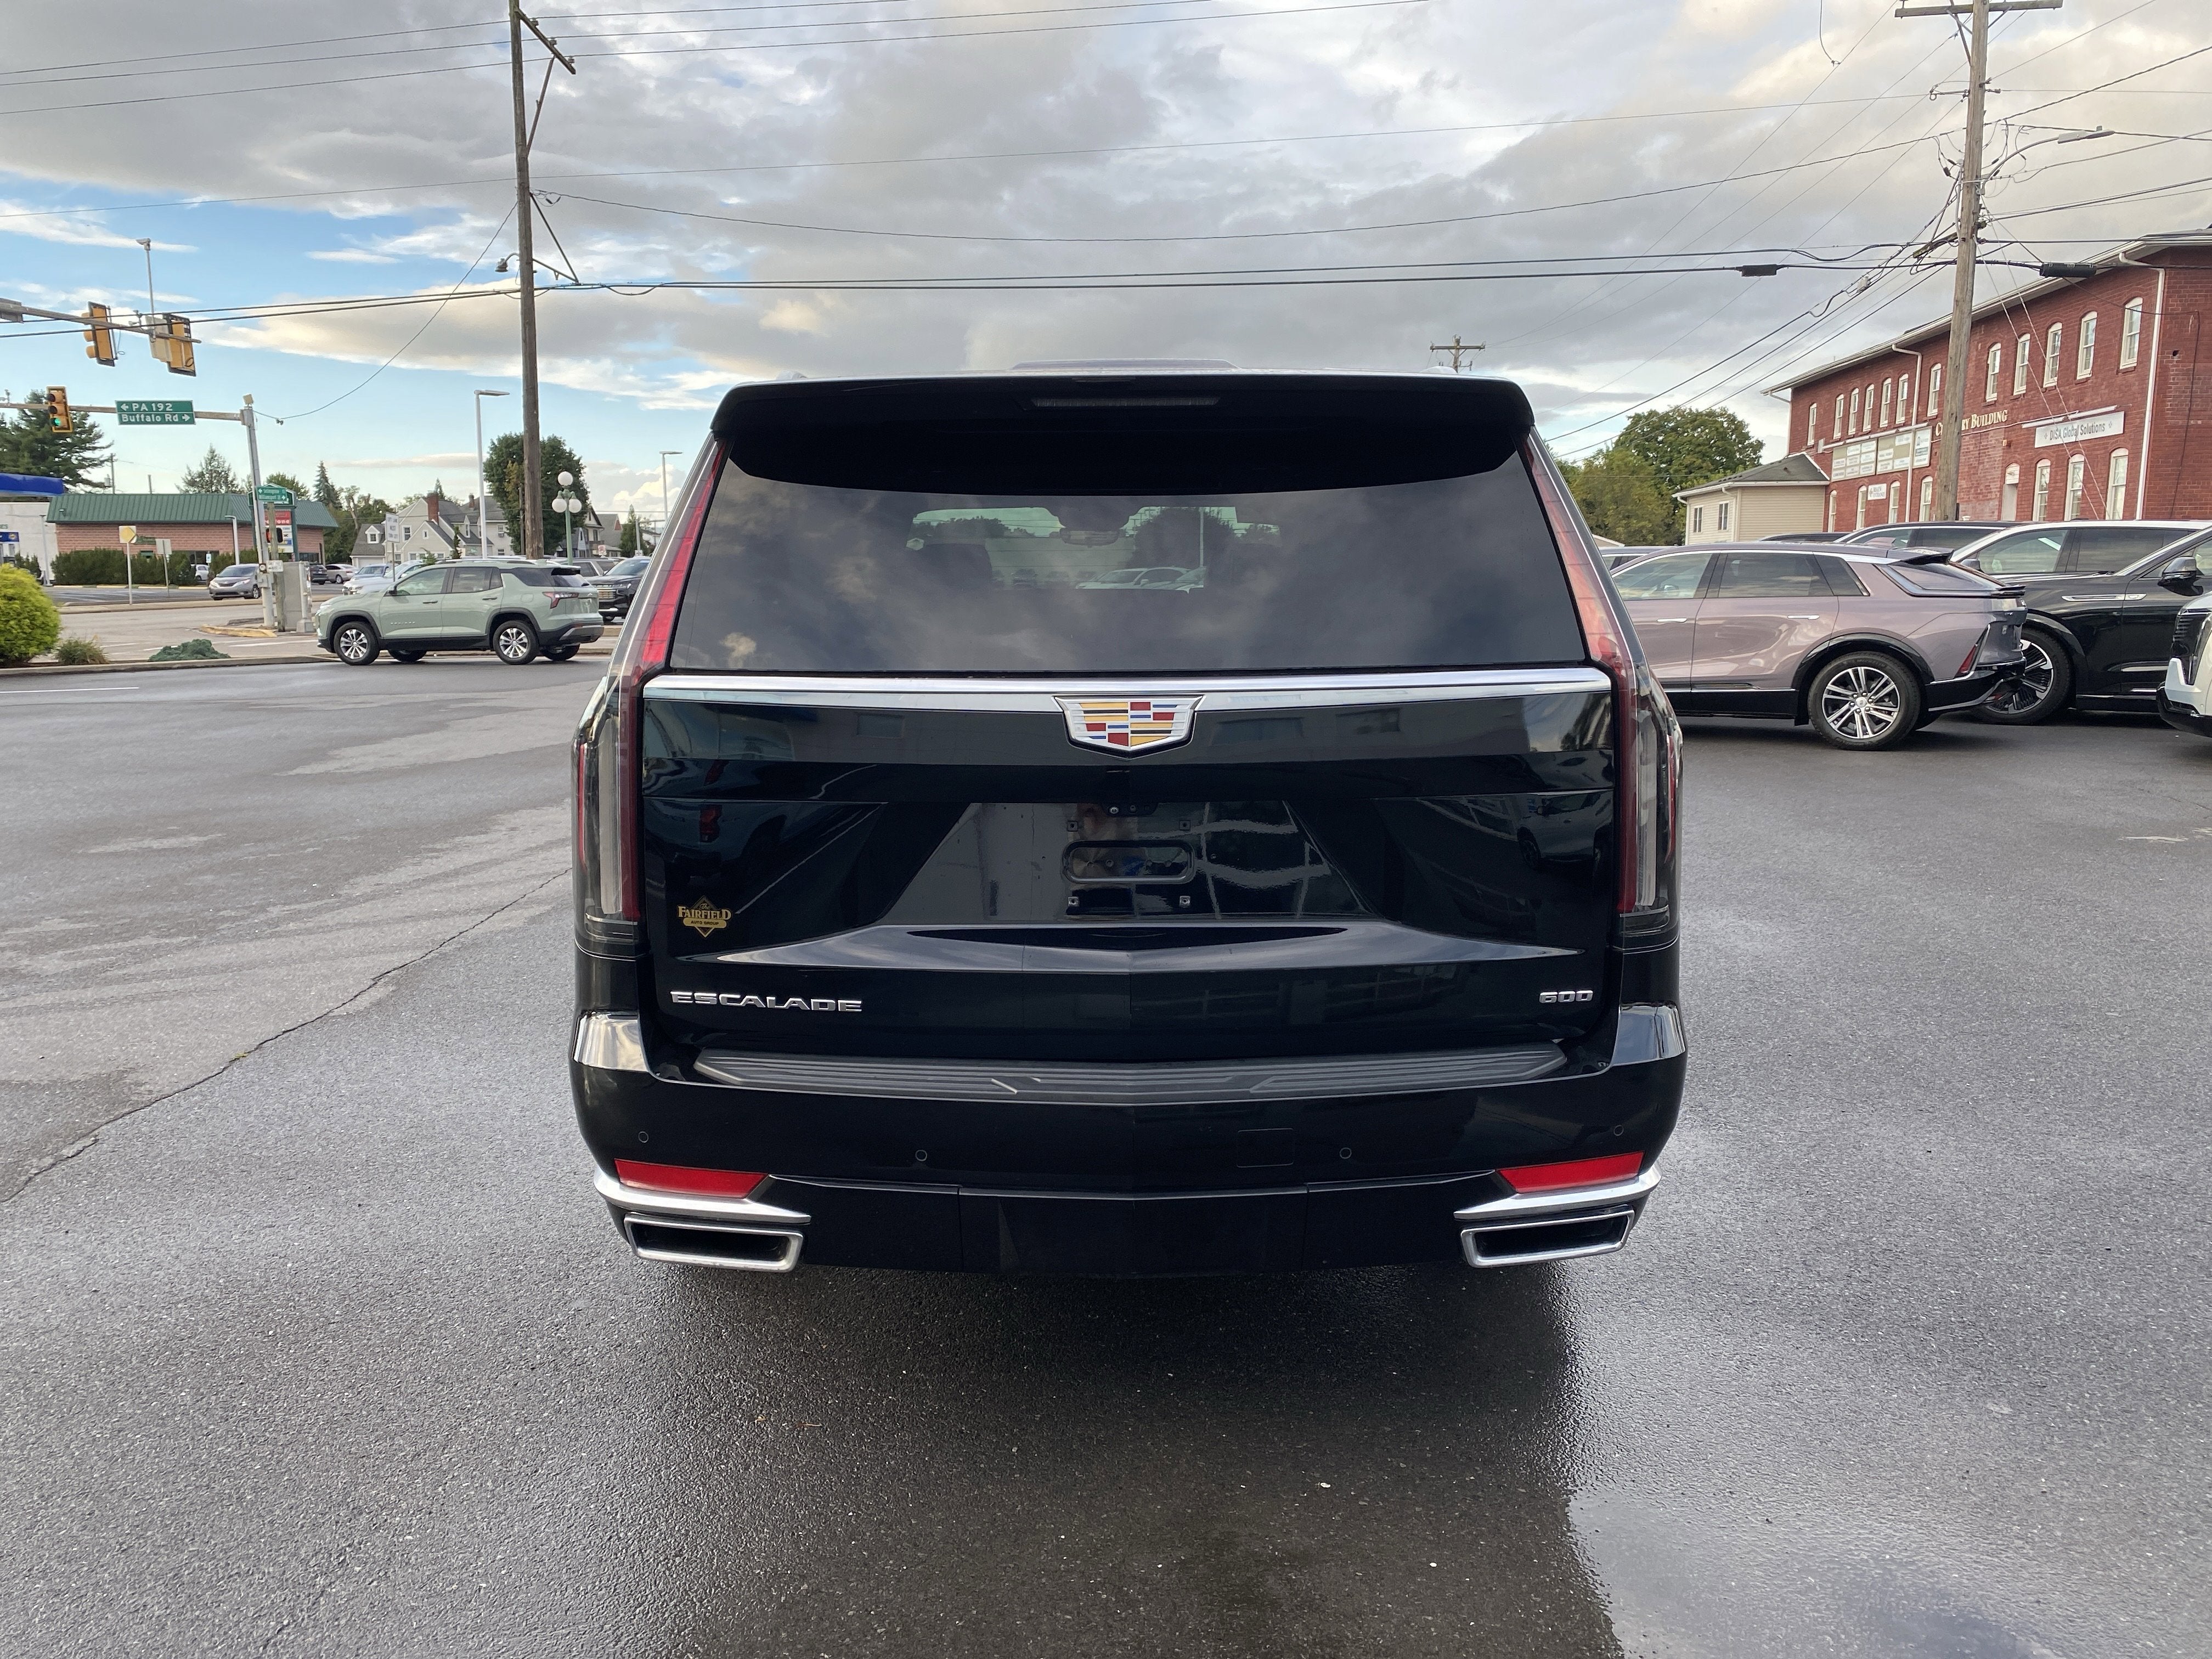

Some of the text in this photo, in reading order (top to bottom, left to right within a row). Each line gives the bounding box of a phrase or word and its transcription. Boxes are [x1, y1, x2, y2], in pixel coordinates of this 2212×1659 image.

[151, 403, 173, 411] 192
[121, 414, 179, 422] Buffalo Rd
[1971, 409, 2008, 428] BUILDING
[2050, 422, 2106, 440] DISA Global Solutions
[678, 906, 731, 920] FAIRFIELD
[670, 991, 862, 1013] ESCALADE
[1539, 990, 1594, 1003] 600
